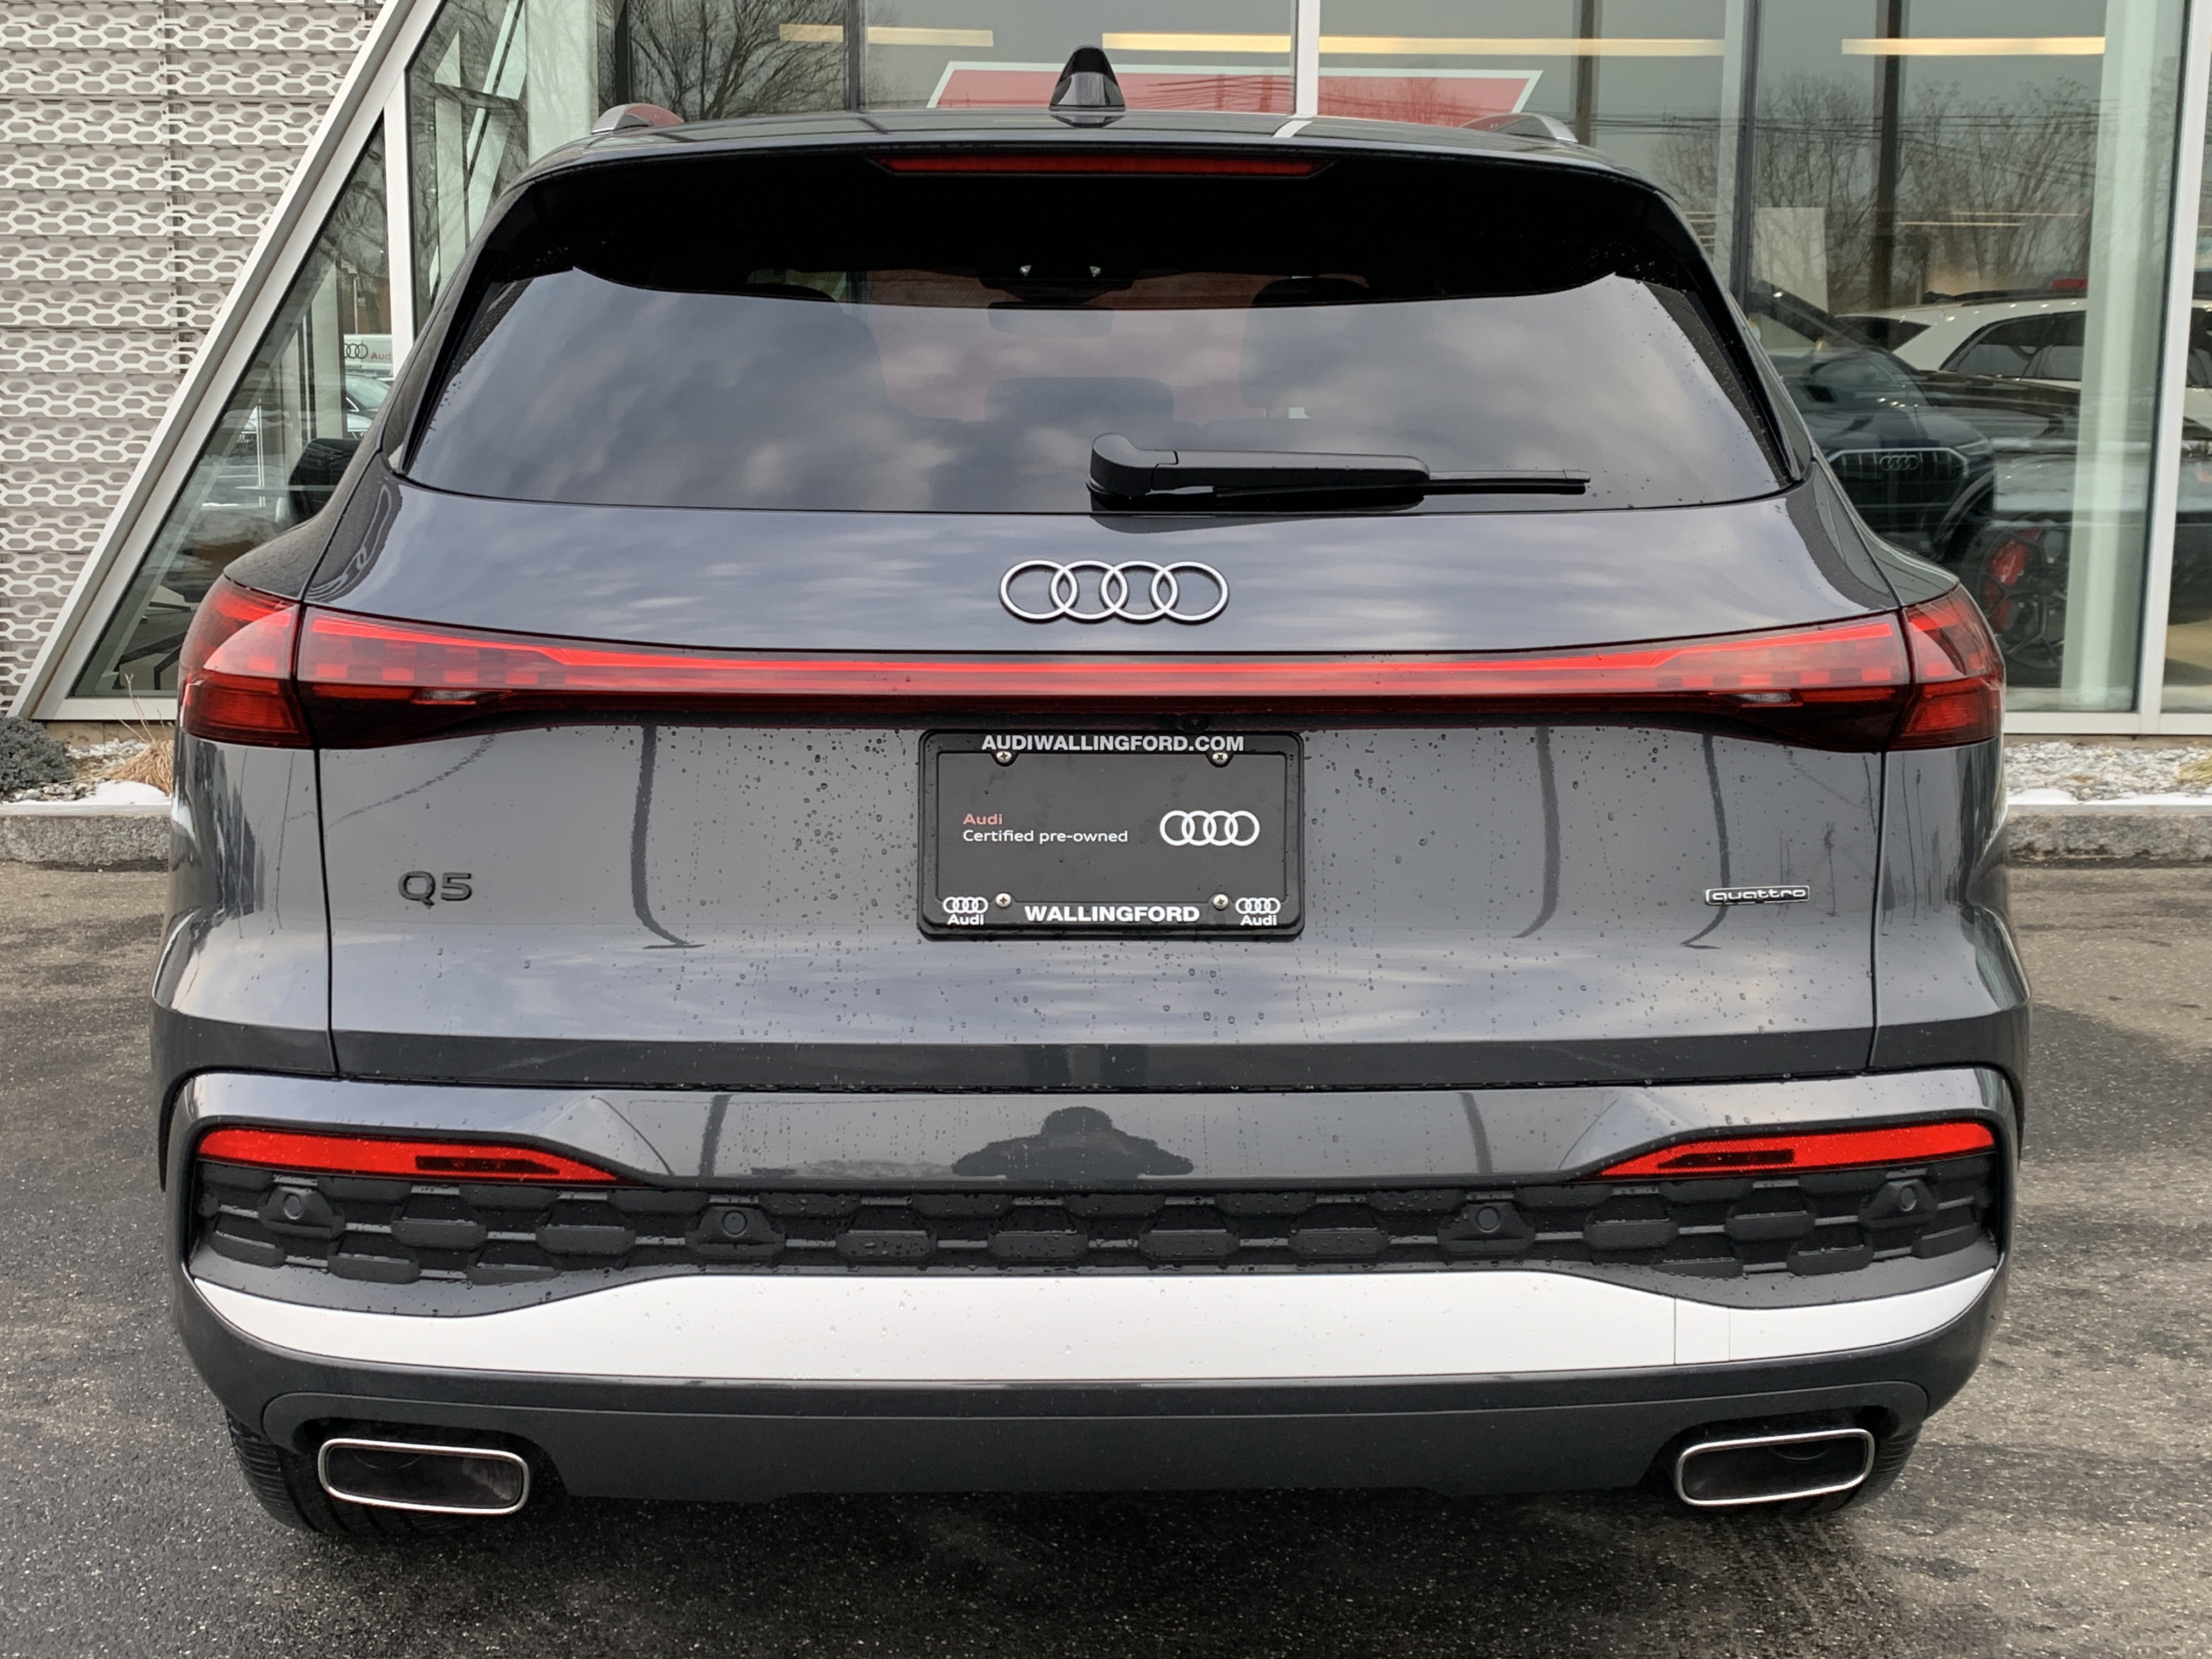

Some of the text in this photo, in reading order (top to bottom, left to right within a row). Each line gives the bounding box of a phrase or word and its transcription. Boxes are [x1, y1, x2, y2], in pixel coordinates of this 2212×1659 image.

[982, 735, 1244, 752] AUDIWALLINGFORD.COM
[963, 814, 1002, 825] Audi
[963, 830, 1128, 844] Certified pre-owned
[399, 871, 472, 906] Q5
[1712, 889, 1806, 901] quattro
[947, 913, 984, 926] Audi
[1025, 906, 1199, 922] WALLINGFORD
[1240, 914, 1277, 926] Audi
